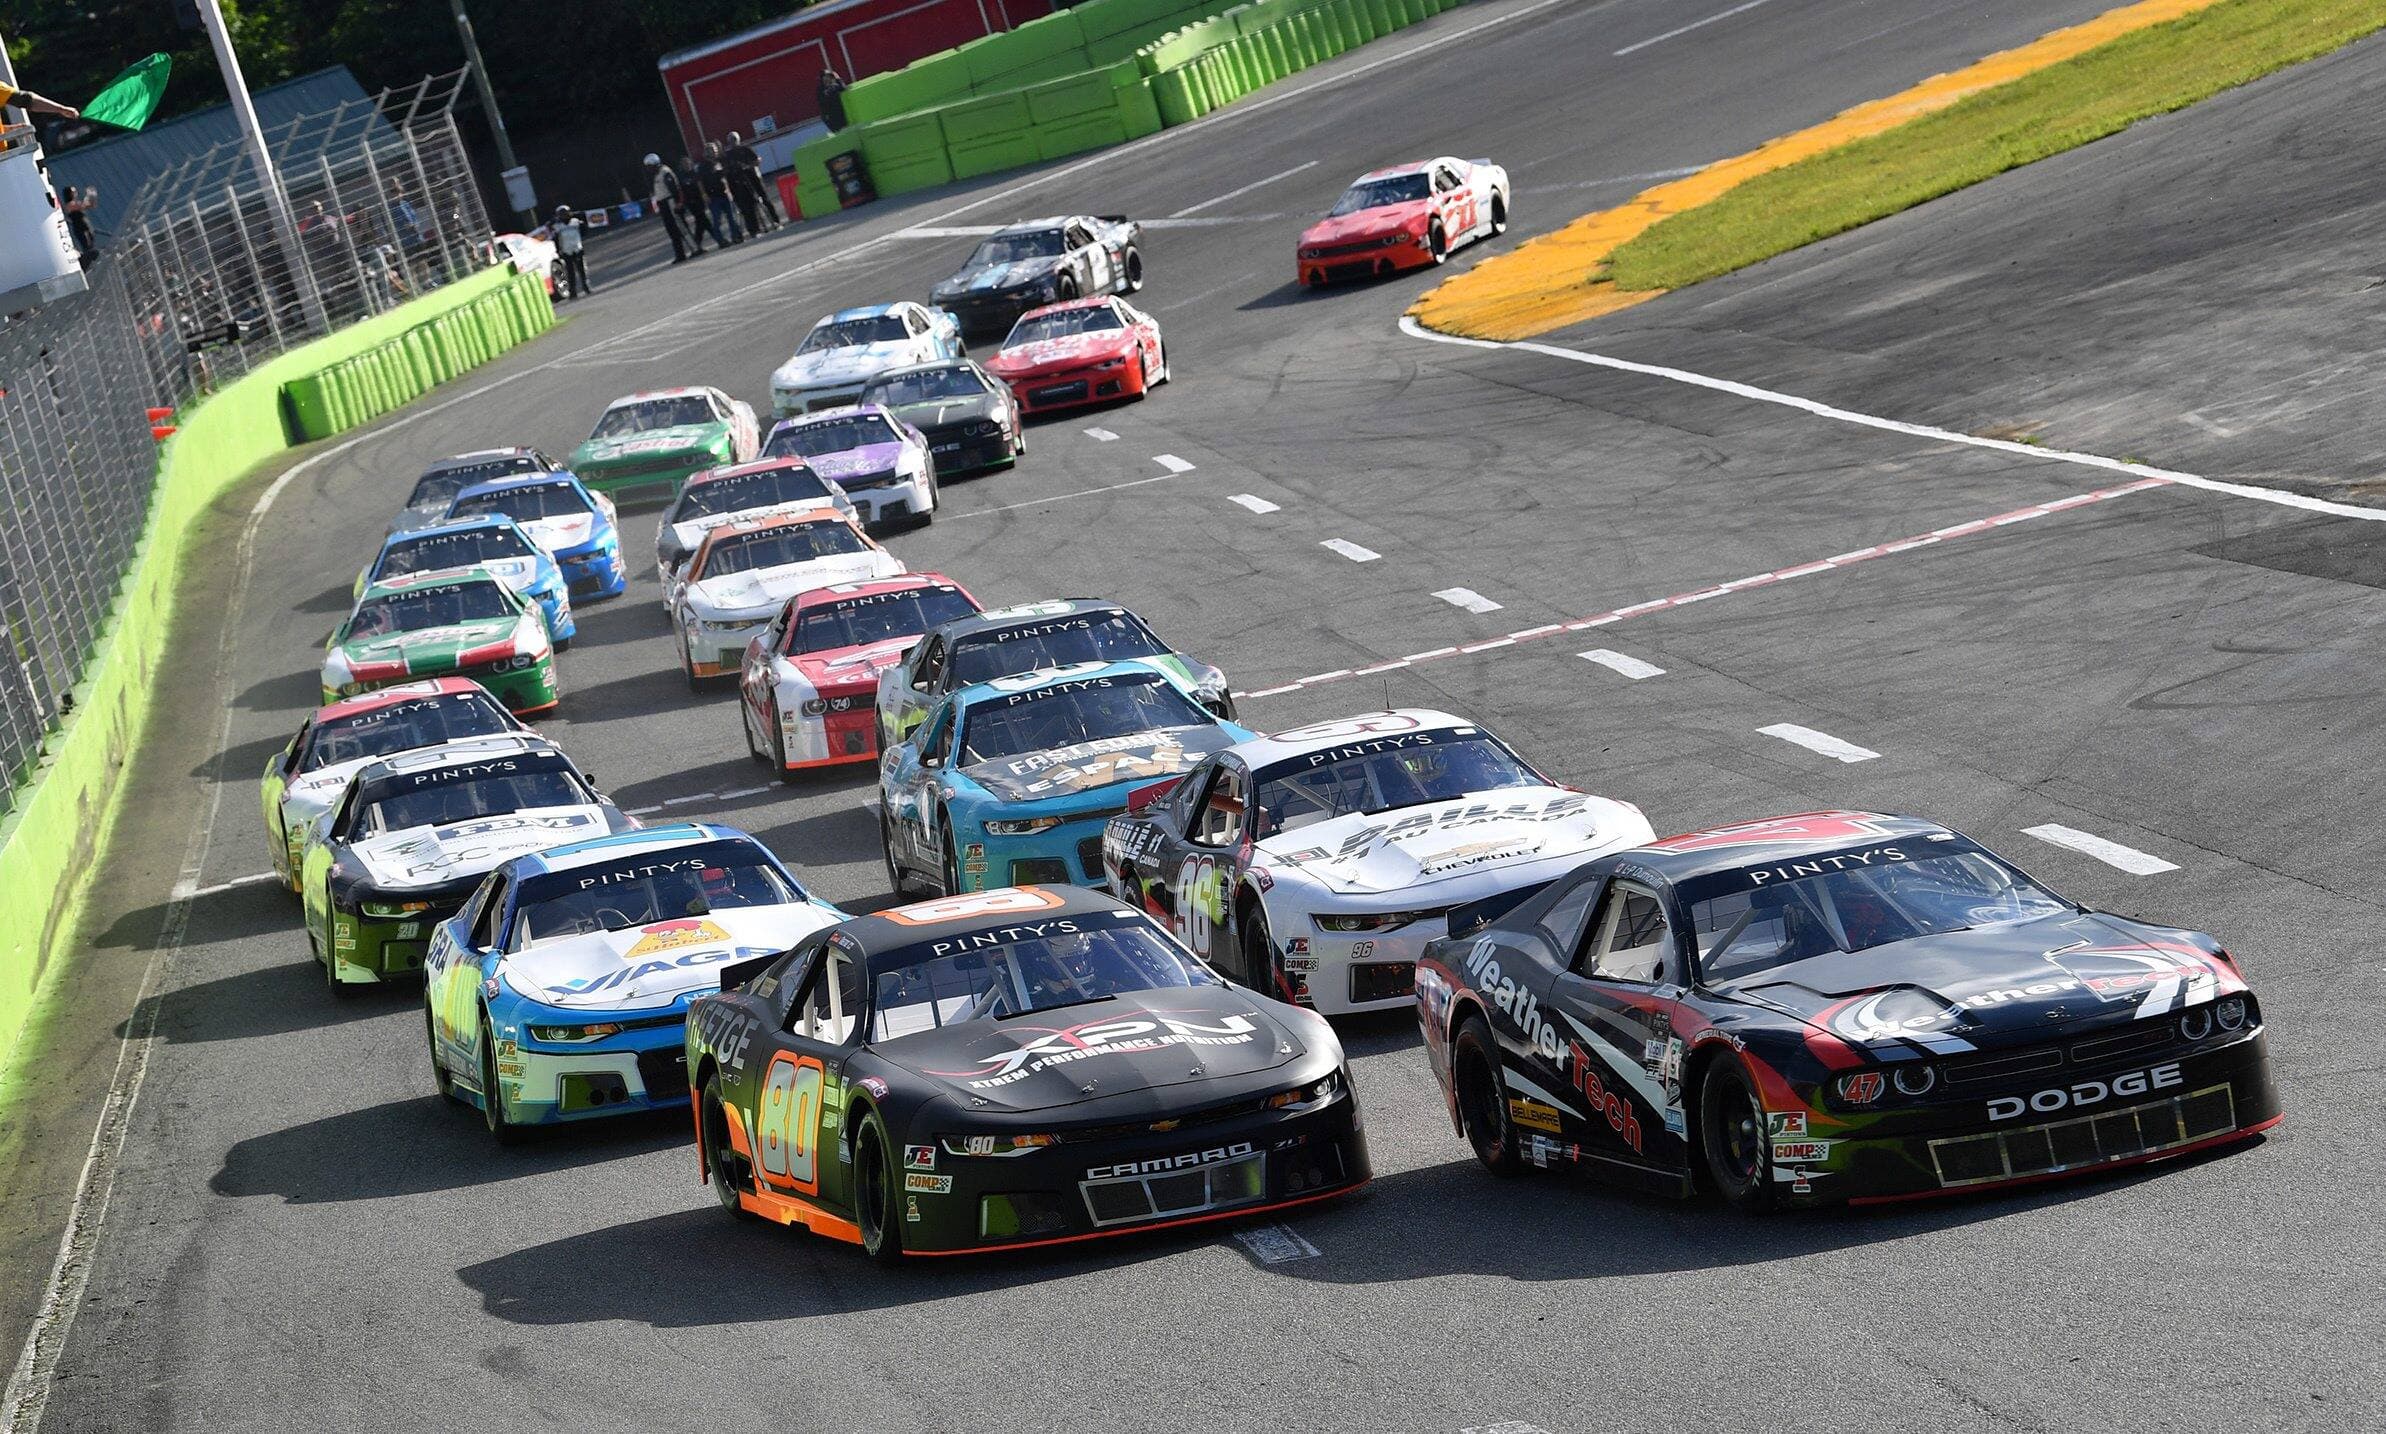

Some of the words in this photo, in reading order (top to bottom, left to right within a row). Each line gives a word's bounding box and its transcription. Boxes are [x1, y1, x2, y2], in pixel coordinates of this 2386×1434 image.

[795, 417, 854, 434] PINTY'S
[713, 471, 778, 488] PINTY'S
[483, 485, 545, 502] PINTY'S
[419, 532, 485, 548] PINTY'S
[743, 523, 814, 542] PINTY'S
[388, 585, 462, 603] PINTY'S
[837, 590, 921, 610] PINTY'S
[997, 619, 1090, 642] PINTY'S
[1009, 678, 1114, 706] PINTY'S
[352, 701, 441, 727] PINTY'S
[1309, 734, 1433, 767] PINTY'S
[415, 761, 517, 785] PINTY'S
[1423, 844, 1548, 875] CHEVROLET
[1749, 847, 1907, 888] PINTY'S
[579, 858, 706, 889] PINTY'S
[1175, 852, 1216, 961] 96
[932, 919, 1079, 957] PINTY'S
[1285, 938, 1308, 954] JE
[1352, 941, 1374, 958] 96
[1286, 960, 1309, 969] COMP
[1464, 933, 1644, 1155] WeatherTech
[968, 1068, 1030, 1090] XTREM
[1030, 1037, 1158, 1072] PERFORMANCE
[1160, 1033, 1254, 1048] NUTRITION
[1844, 1072, 1881, 1104] 47
[1987, 1063, 2184, 1121] DODGE
[760, 1049, 826, 1197] 80
[1512, 1104, 1559, 1127] BELLEMARE
[1769, 1113, 1803, 1136] JE
[906, 1146, 933, 1166] JE
[968, 1135, 995, 1155] 80
[1775, 1143, 1814, 1158] COMP
[1087, 1142, 1252, 1180] CAMARO
[907, 1175, 940, 1188] COMP
